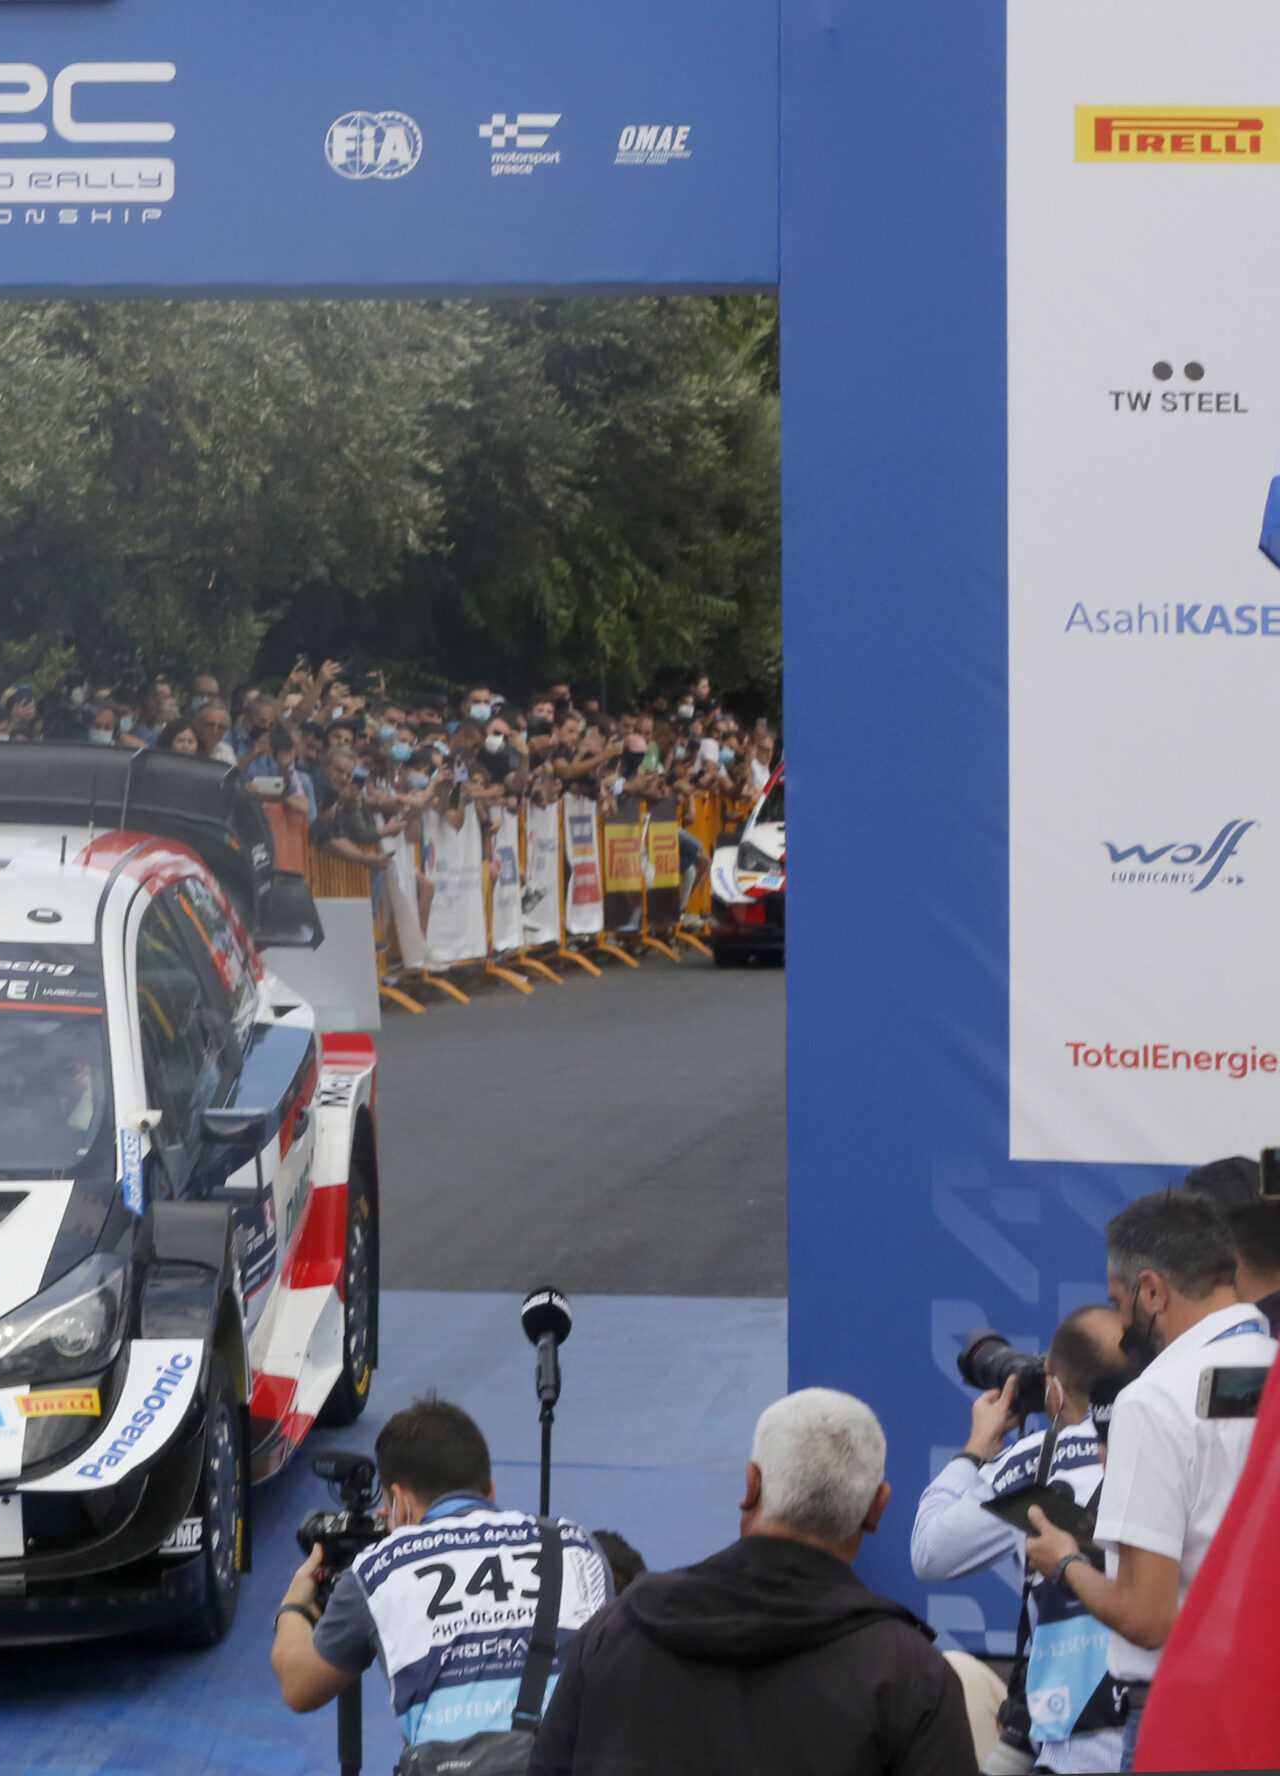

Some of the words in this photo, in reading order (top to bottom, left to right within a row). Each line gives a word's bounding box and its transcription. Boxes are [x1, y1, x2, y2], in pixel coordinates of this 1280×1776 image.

[618, 125, 691, 151] OMAE
[1094, 117, 1264, 154] PIRELLI
[491, 151, 562, 166] motorsport
[29, 172, 163, 189] RALLY
[1109, 391, 1152, 412] TW
[1161, 392, 1249, 414] STEEL
[1111, 871, 1195, 884] LUBRICANTS
[21, 1392, 96, 1413] PIRELLI
[77, 1351, 193, 1481] Panasonic
[392, 1529, 480, 1561] ACROPOLIS
[414, 1550, 542, 1620] 243
